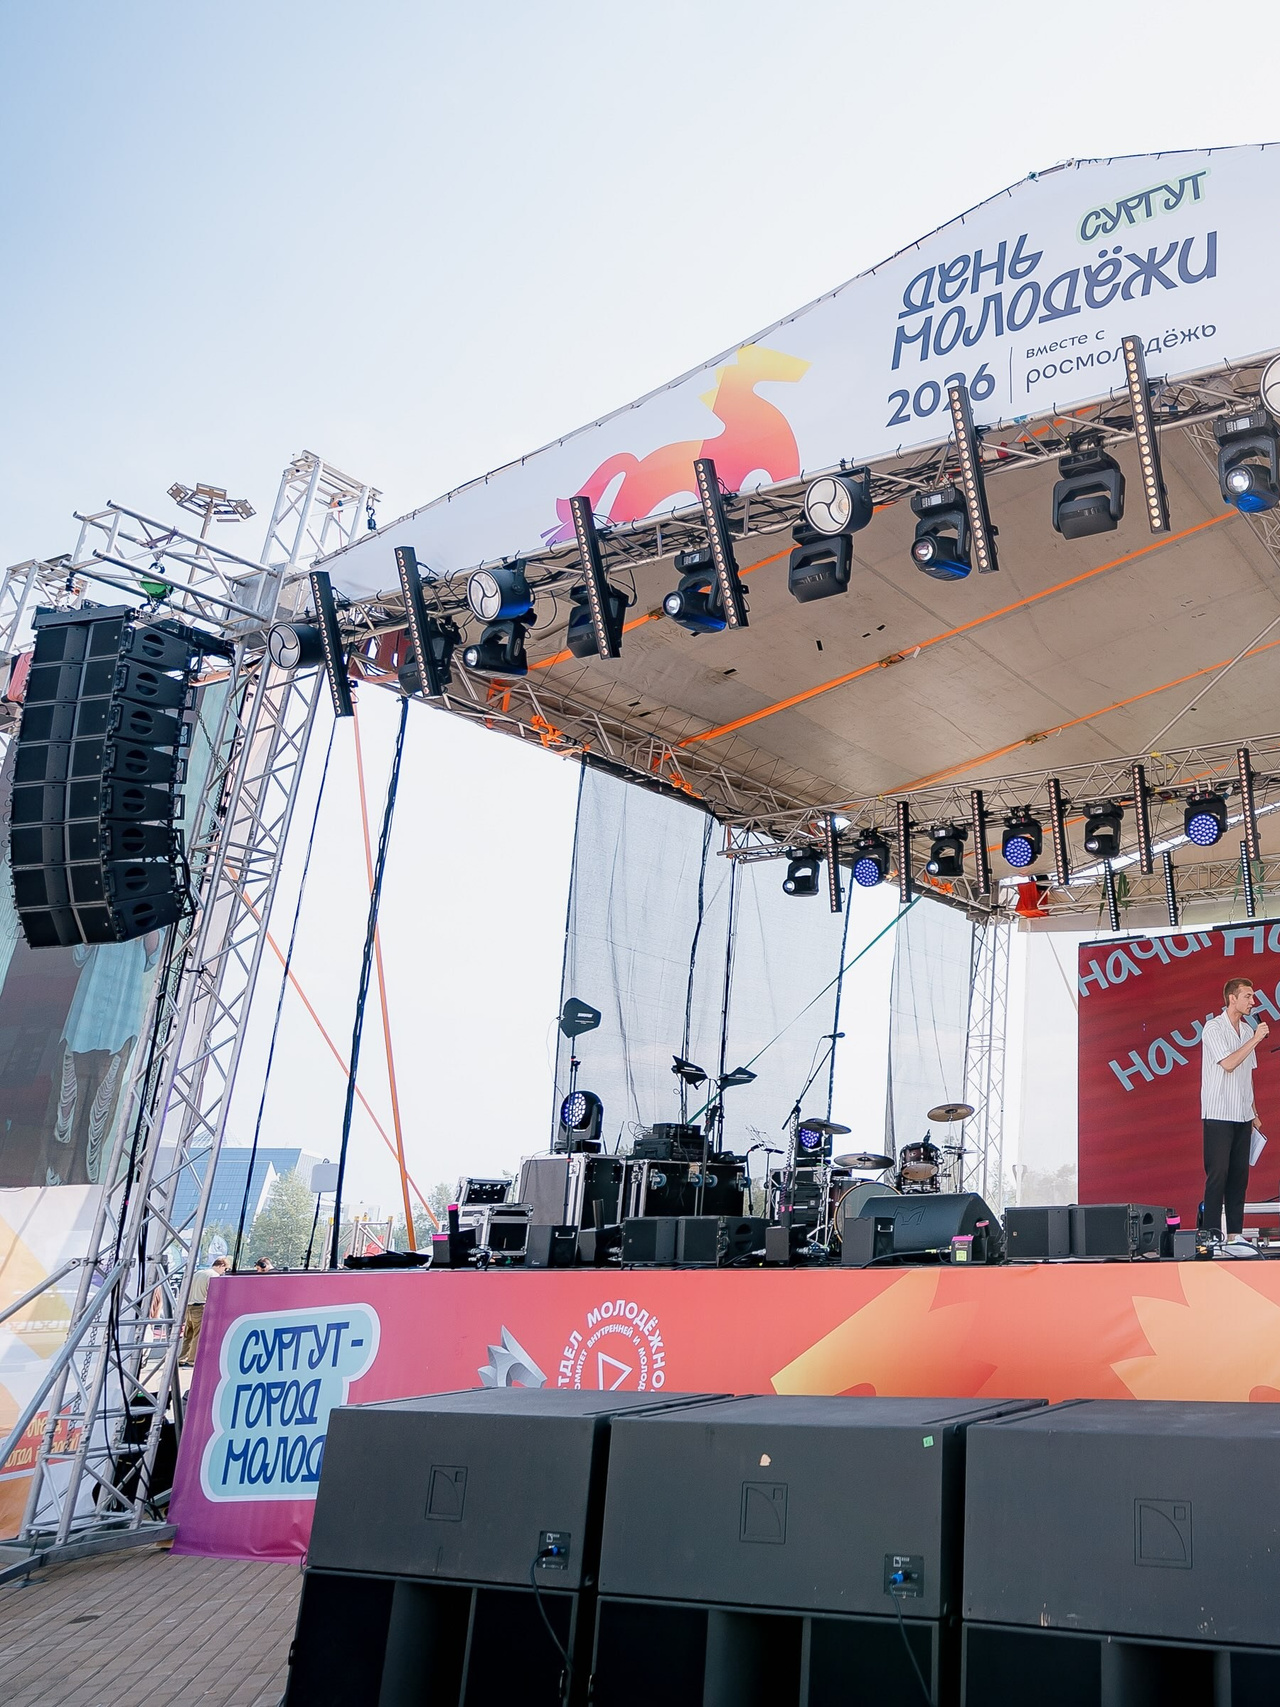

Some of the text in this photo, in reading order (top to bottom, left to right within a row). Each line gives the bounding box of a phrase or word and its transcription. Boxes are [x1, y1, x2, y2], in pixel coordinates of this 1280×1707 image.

[1080, 170, 1207, 242] СУРГУТ
[1025, 329, 1105, 359] вместе с
[1026, 323, 1217, 393] росмолдёжь
[239, 1321, 364, 1375] СУРГУТ-
[557, 1299, 666, 1392] ТДЕЛ МОЛОДЁЖНО
[586, 1323, 634, 1349] ВНУТРЕННЕЙ
[632, 1335, 641, 1346] И
[230, 1378, 322, 1429] ГОРОД
